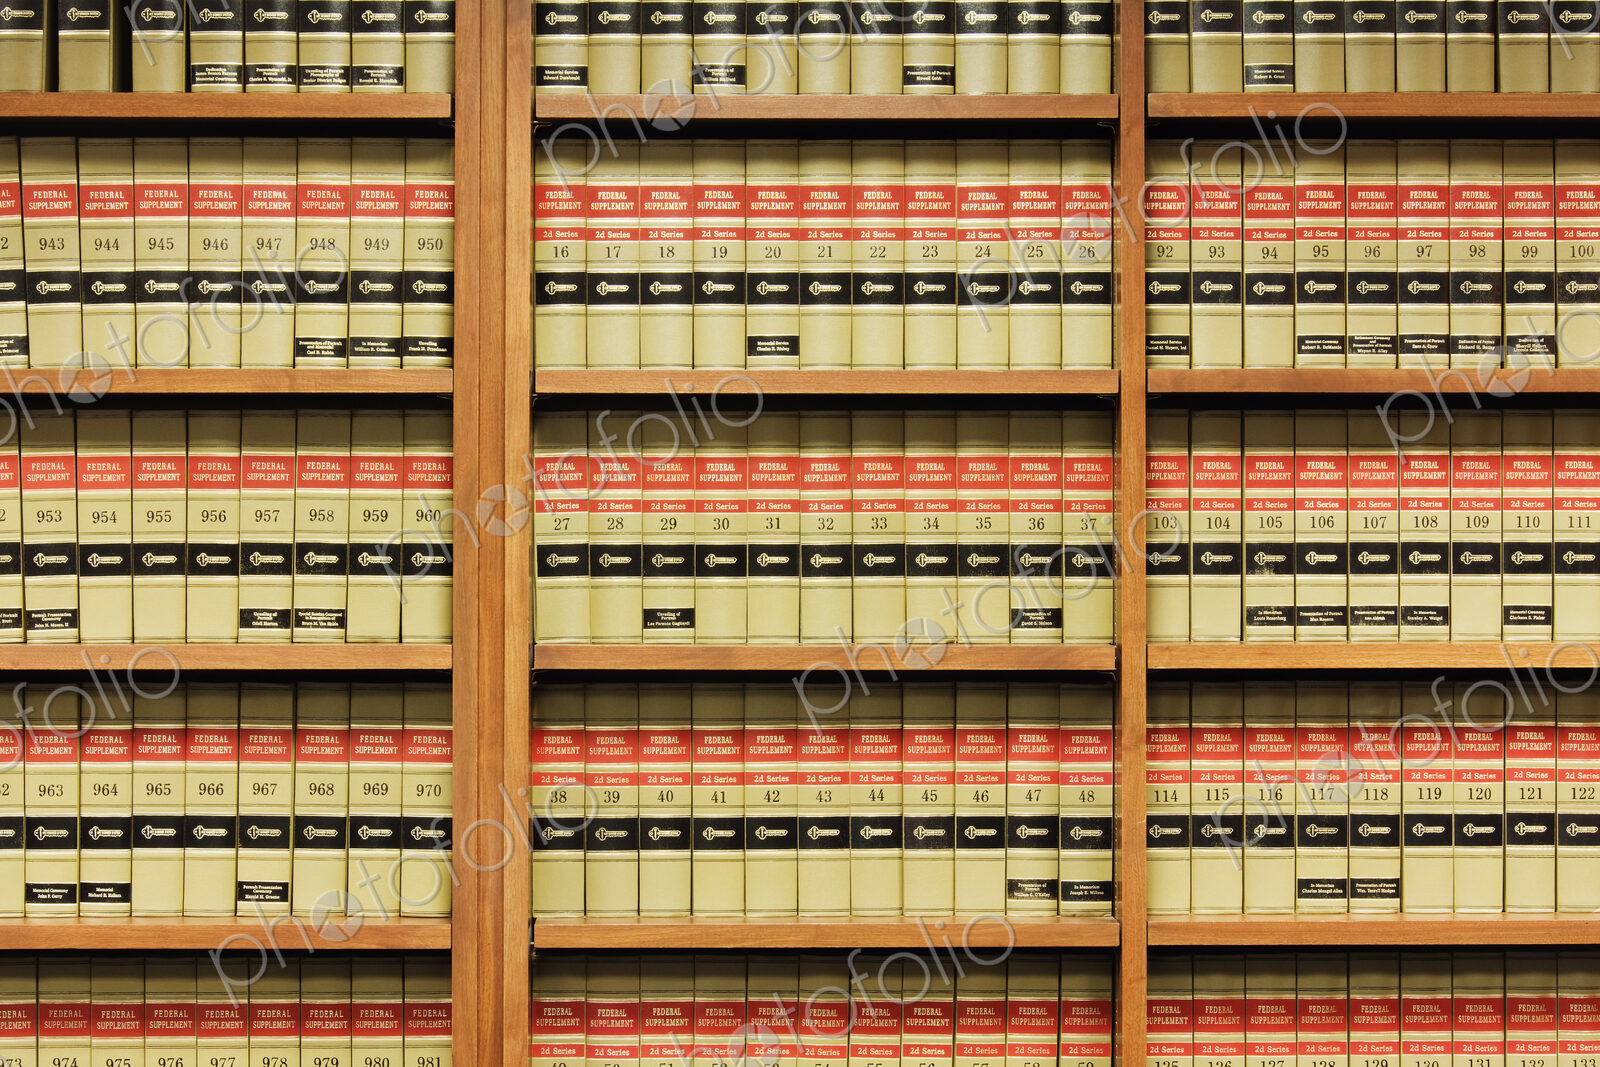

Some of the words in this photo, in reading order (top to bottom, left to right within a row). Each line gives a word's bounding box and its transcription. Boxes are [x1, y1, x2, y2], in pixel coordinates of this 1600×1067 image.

[143, 189, 180, 199] FEDERAL
[810, 191, 840, 200] FEDERAL
[1409, 190, 1439, 199] FEDERAL
[139, 200, 184, 210] SUPPLEMENT
[802, 201, 847, 211] SUPPLEMENT
[1401, 201, 1447, 211] SUPPLEMENT
[807, 230, 818, 239] 2d
[819, 230, 844, 239] Series
[1407, 229, 1417, 238] 2d
[1418, 230, 1442, 238] Series
[39, 237, 65, 251] 943
[94, 238, 120, 251] 944
[148, 237, 174, 251] 945
[202, 237, 229, 251] 946
[256, 237, 282, 251] 947
[364, 238, 390, 251] 949
[417, 237, 444, 251] 950
[553, 245, 570, 259] 16
[605, 246, 622, 259] 17
[659, 246, 675, 259] 18
[712, 246, 728, 259] 19
[765, 246, 782, 259] 20
[816, 245, 833, 258] 21
[922, 245, 939, 258] 23
[1208, 245, 1226, 259] 93
[1261, 246, 1279, 260] 94
[1312, 244, 1330, 258] 95
[1364, 245, 1381, 258] 96
[1415, 245, 1432, 258] 97
[1469, 244, 1486, 258] 98
[1521, 245, 1538, 259] 99
[196, 462, 233, 471] FEDERAL
[915, 462, 946, 472] FEDERAL
[1410, 460, 1440, 470] FEDERAL
[192, 473, 237, 482] SUPPLEMENT
[908, 473, 953, 482] SUPPLEMENT
[1403, 471, 1447, 480] SUPPLEMENT
[913, 502, 924, 510] 2d
[925, 502, 950, 510] Series
[1408, 499, 1418, 508] 2d
[1419, 500, 1443, 508] Series
[36, 509, 63, 523] 953
[91, 510, 118, 524] 954
[146, 510, 172, 524] 955
[201, 509, 227, 523] 956
[254, 509, 281, 523] 957
[309, 508, 335, 522] 958
[362, 509, 389, 523] 959
[1517, 515, 1541, 528] 110
[606, 516, 625, 530] 28
[660, 517, 678, 531] 29
[713, 517, 731, 530] 30
[764, 516, 782, 530] 31
[817, 517, 835, 531] 32
[870, 516, 889, 530] 33
[922, 516, 940, 530] 34
[1206, 516, 1231, 530] 104
[1259, 515, 1283, 529] 105
[1310, 515, 1335, 529] 106
[1363, 516, 1388, 529] 107
[1414, 515, 1438, 529] 108
[1465, 515, 1490, 529] 109
[142, 734, 177, 743] FEDERAL
[808, 734, 838, 744] FEDERAL
[137, 745, 182, 754] SUPPLEMENT
[801, 745, 846, 755] SUPPLEMENT
[806, 774, 817, 783] 2d
[818, 774, 842, 783] Series
[38, 784, 64, 797] 963
[93, 783, 119, 797] 964
[198, 782, 224, 796] 966
[252, 782, 278, 796] 967
[308, 782, 335, 797] 968
[416, 783, 442, 797] 970
[921, 789, 938, 802] 45
[1206, 788, 1230, 802] 115
[1364, 787, 1389, 801] 118
[1418, 786, 1442, 800] 119
[1468, 787, 1492, 801] 120
[1519, 787, 1543, 800] 121
[1570, 787, 1595, 800] 122
[603, 790, 621, 804] 39
[710, 790, 727, 804] 41
[763, 789, 780, 803] 42
[816, 790, 833, 803] 43
[972, 789, 989, 803] 46
[1079, 789, 1095, 803] 48
[359, 1009, 395, 1018] FEDERAL
[597, 1008, 627, 1018] FEDERAL
[1257, 1005, 1287, 1014] FEDERAL
[354, 1020, 399, 1029] SUPPLEMENT
[589, 1019, 635, 1028] SUPPLEMENT
[1250, 1015, 1294, 1025] SUPPLEMENT
[594, 1047, 605, 1056] 2d
[606, 1048, 630, 1057] Series
[1254, 1045, 1265, 1053] 2d
[1266, 1045, 1290, 1053] Series
